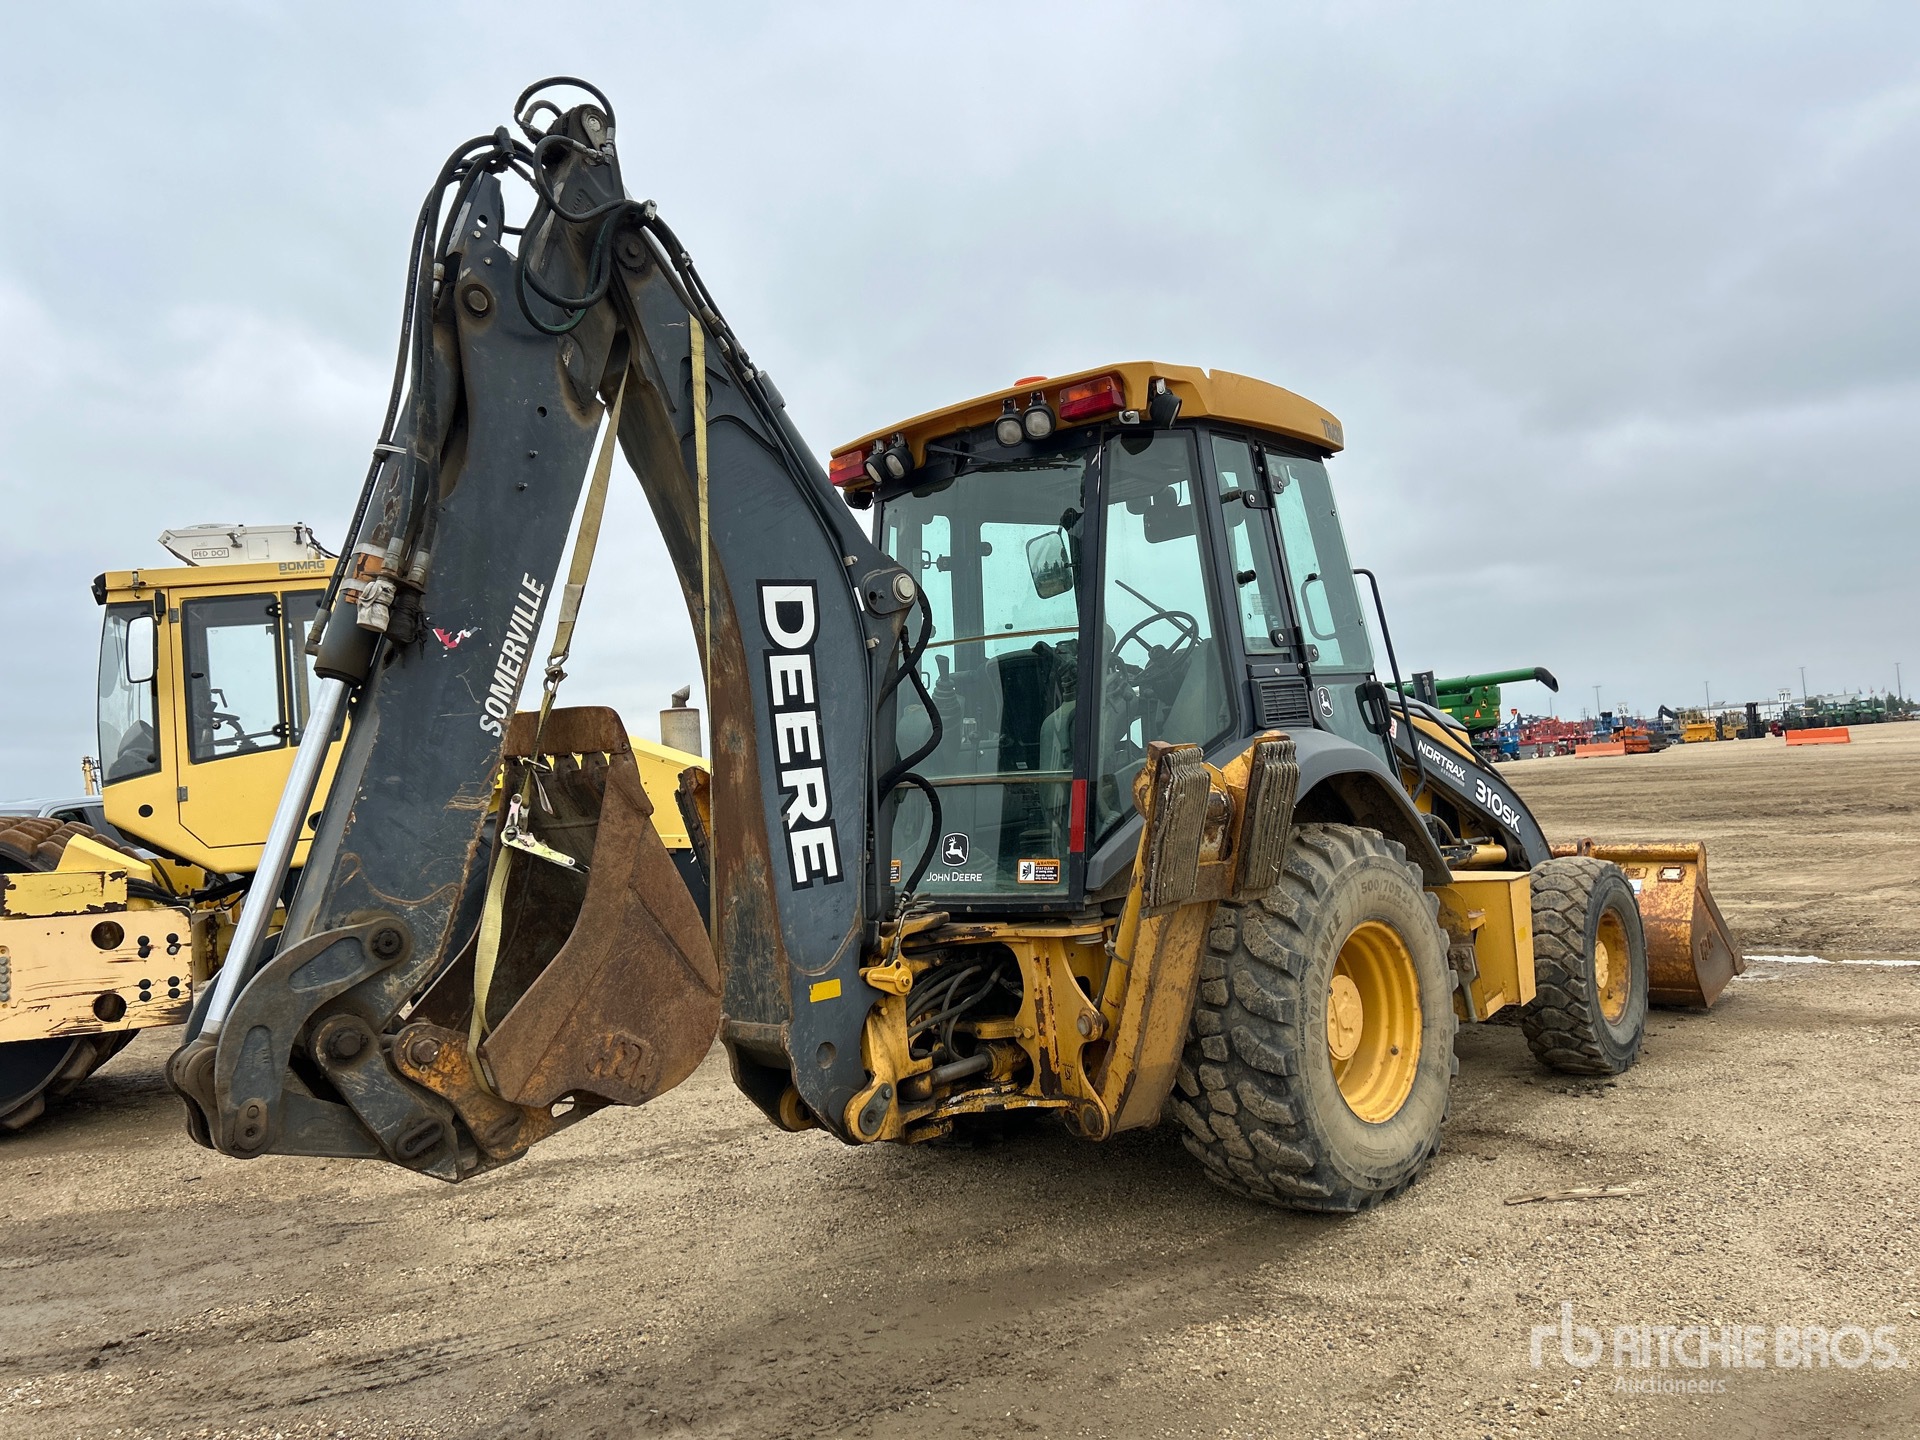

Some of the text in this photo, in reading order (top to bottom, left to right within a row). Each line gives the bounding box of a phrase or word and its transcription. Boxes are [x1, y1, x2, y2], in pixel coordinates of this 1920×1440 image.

[193, 549, 227, 558] RED DOT
[278, 560, 326, 571] BOMAG
[479, 572, 546, 738] SOMERVILLE
[761, 585, 838, 884] DEERE
[1417, 739, 1466, 781] NORTRAX
[1475, 777, 1522, 834] 310SK
[926, 871, 983, 882] JOHN DEERE
[1309, 908, 1343, 1044] ALLIANCE
